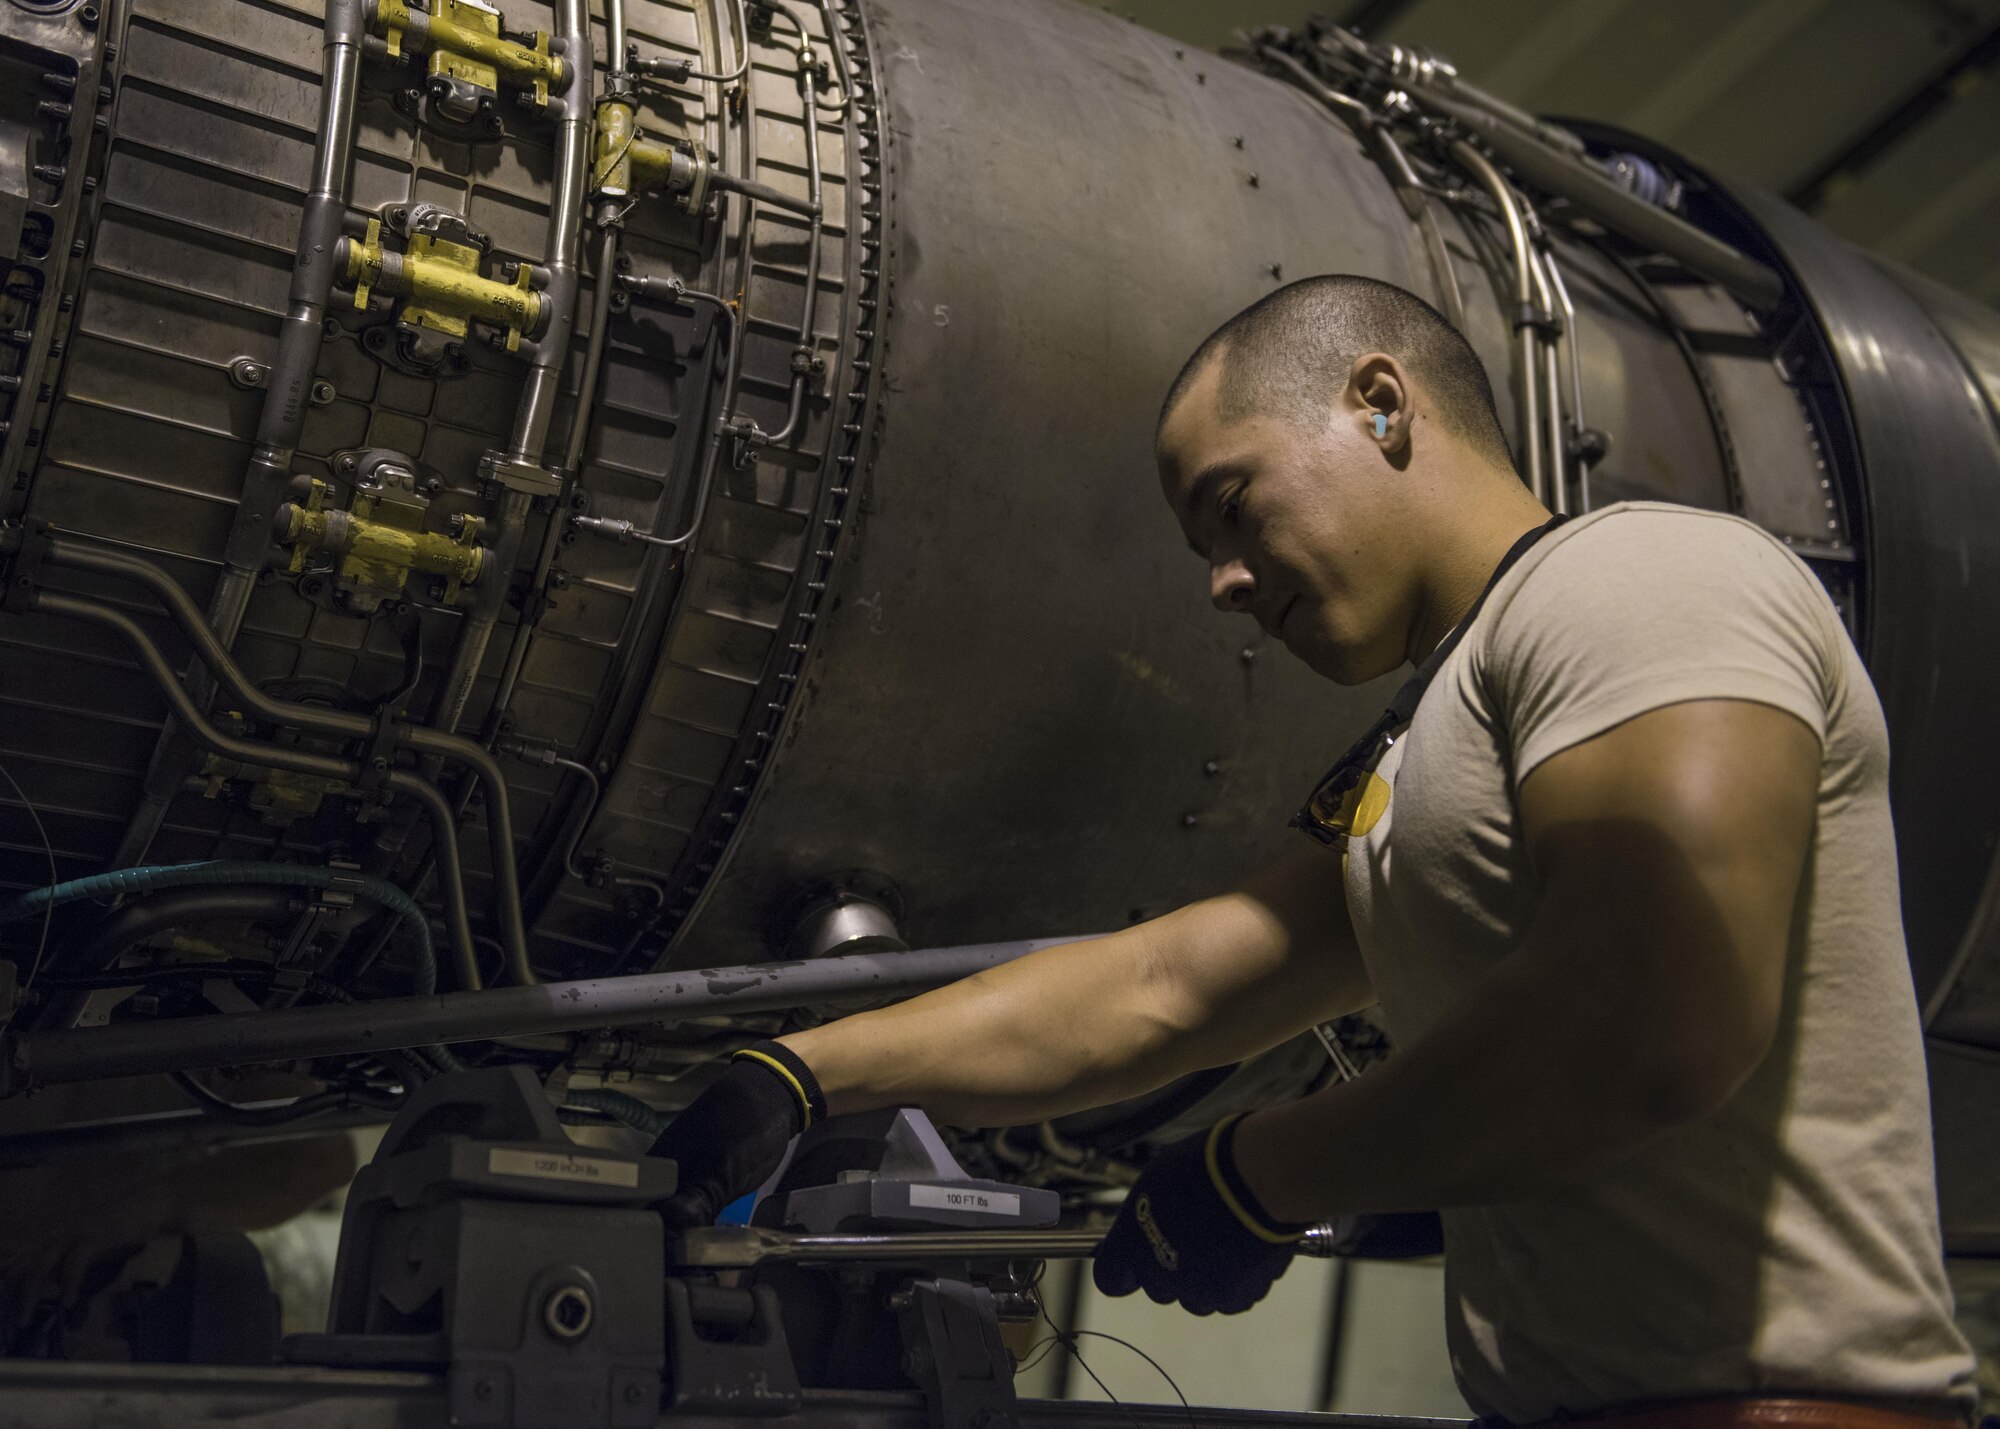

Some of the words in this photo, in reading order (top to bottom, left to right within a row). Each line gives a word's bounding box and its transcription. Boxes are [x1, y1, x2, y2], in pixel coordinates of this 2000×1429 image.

[366, 258, 382, 268] FAN
[491, 295, 512, 306] CORE
[515, 298, 524, 313] TOP
[934, 304, 950, 327] 5
[305, 525, 321, 535] FAN
[432, 554, 454, 566] CORE
[947, 1194, 962, 1205] 100
[963, 1195, 976, 1206] FT
[977, 1196, 988, 1207] lbs
